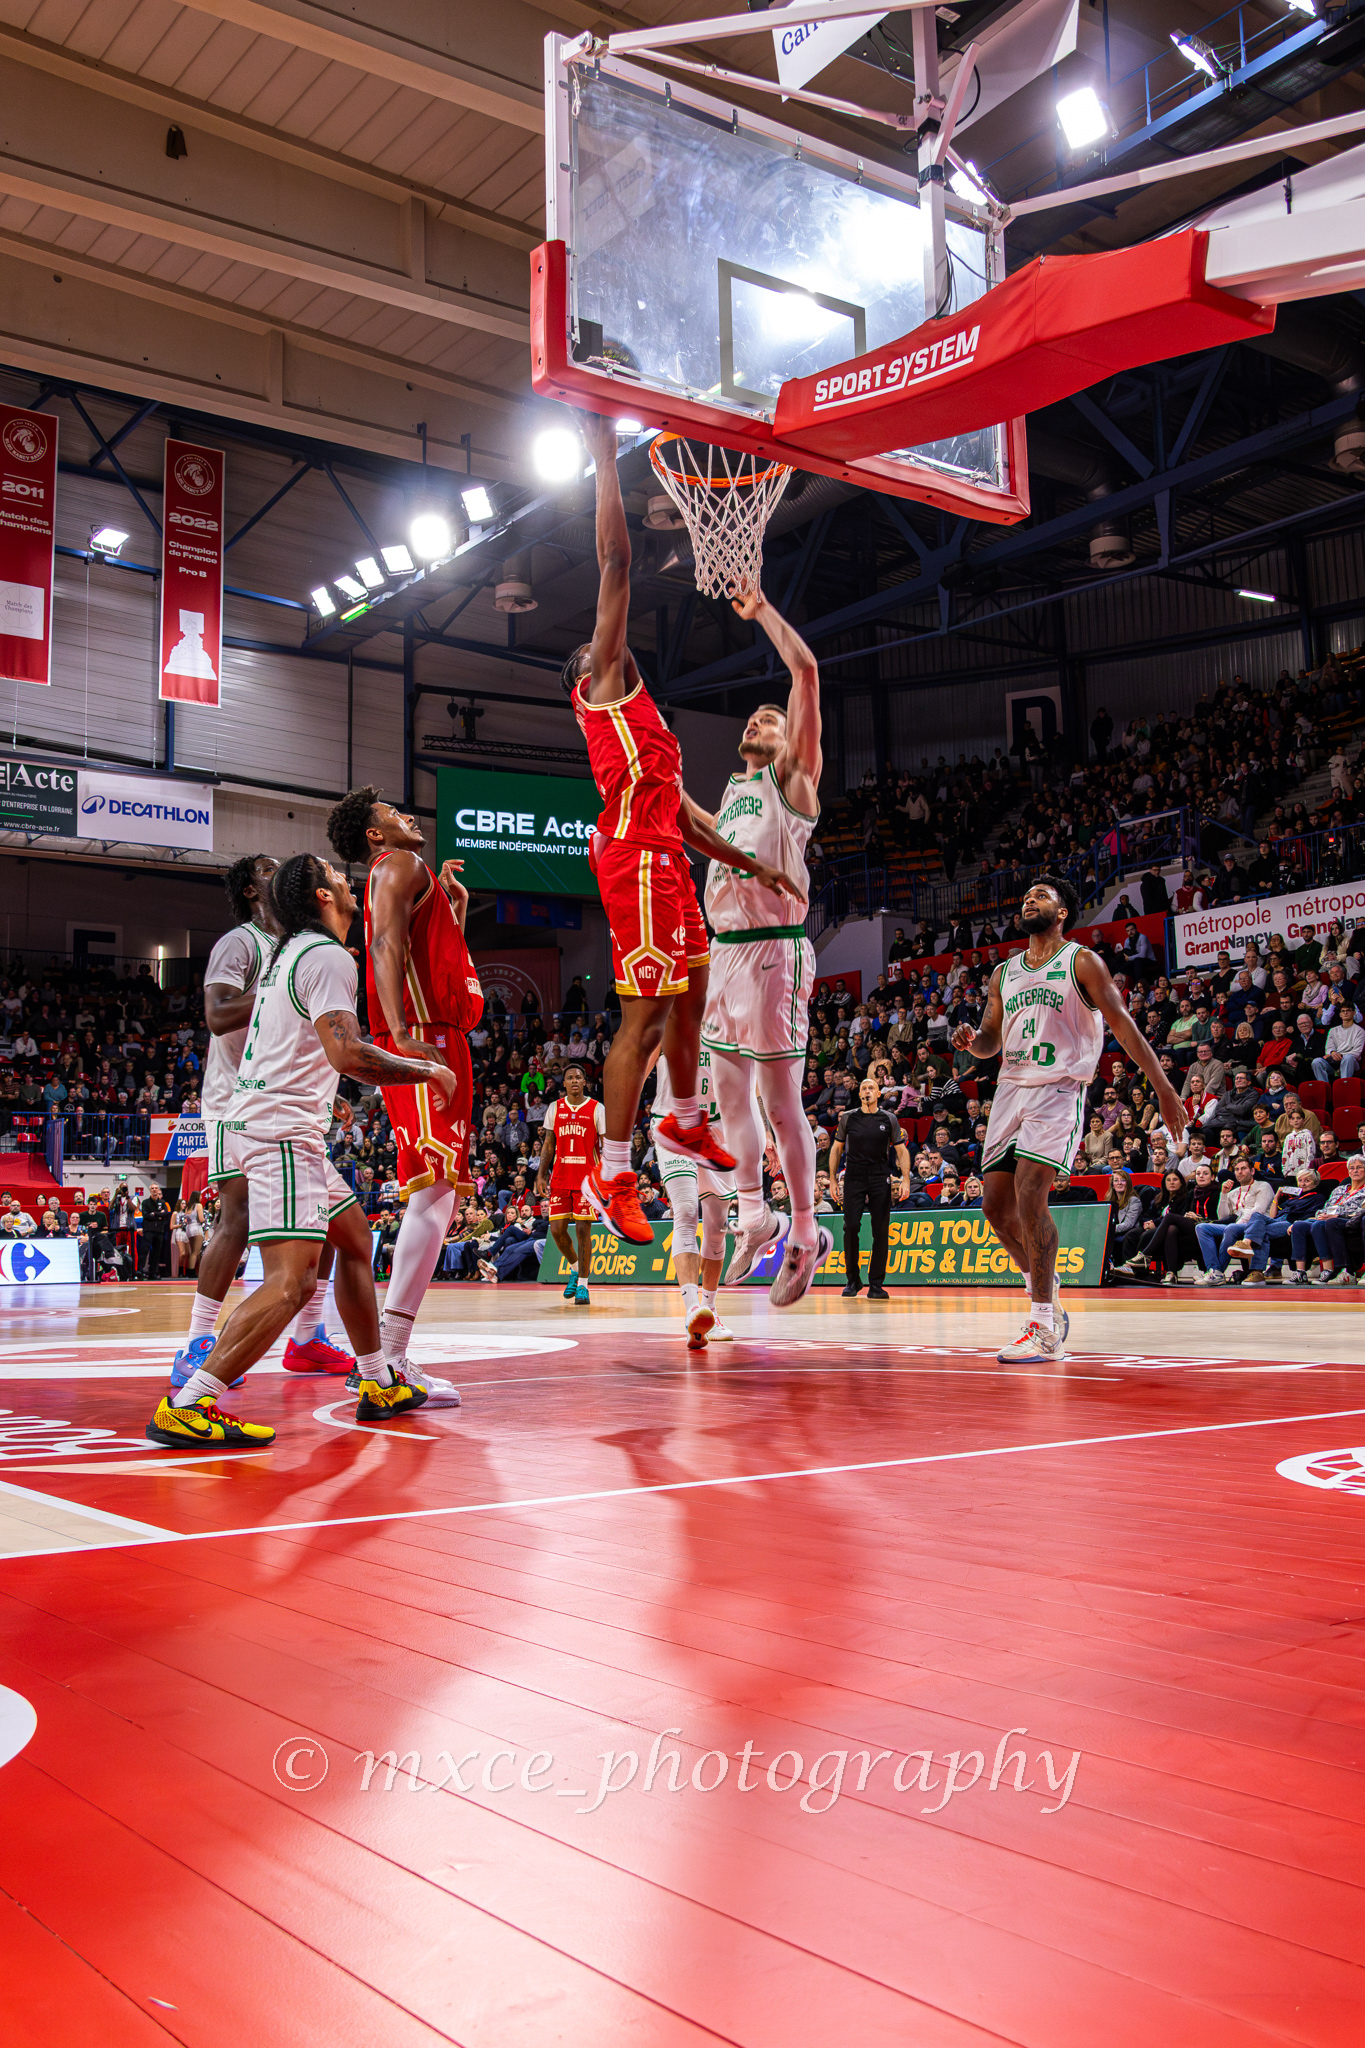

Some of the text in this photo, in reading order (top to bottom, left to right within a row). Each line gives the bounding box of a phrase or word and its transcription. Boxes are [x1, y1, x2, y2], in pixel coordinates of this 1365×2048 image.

[814, 325, 981, 403] SPORT SYSTEM
[2, 481, 45, 499] 2011
[0, 519, 52, 536] hampions
[30, 517, 49, 527] des
[169, 512, 219, 532] 2022
[168, 541, 218, 557] Champion
[168, 549, 218, 565] de France
[178, 566, 207, 578] Pro B
[11, 763, 74, 792] Acte
[47, 806, 74, 815] LORRAINE
[109, 799, 210, 825] DECATHLON
[3, 821, 60, 833] www.cbre-acte.fr
[455, 809, 598, 840] CBRE Acte
[456, 838, 498, 850] MEMBRE
[499, 840, 567, 855] INDÉPENDANT
[568, 846, 583, 856] DU
[1183, 907, 1272, 938] métropole
[1184, 931, 1272, 957] GrandNancy
[638, 965, 658, 979] NCY
[1022, 1018, 1036, 1039] 24
[701, 1077, 709, 1096] 6
[559, 1124, 587, 1138] NANCY
[570, 1138, 575, 1153] 1
[887, 1219, 1001, 1245] SUR TOUS
[590, 1233, 619, 1254] OUS
[857, 1249, 937, 1274] FUITS
[939, 1251, 956, 1274] &
[961, 1240, 1085, 1274] LÉGUES
